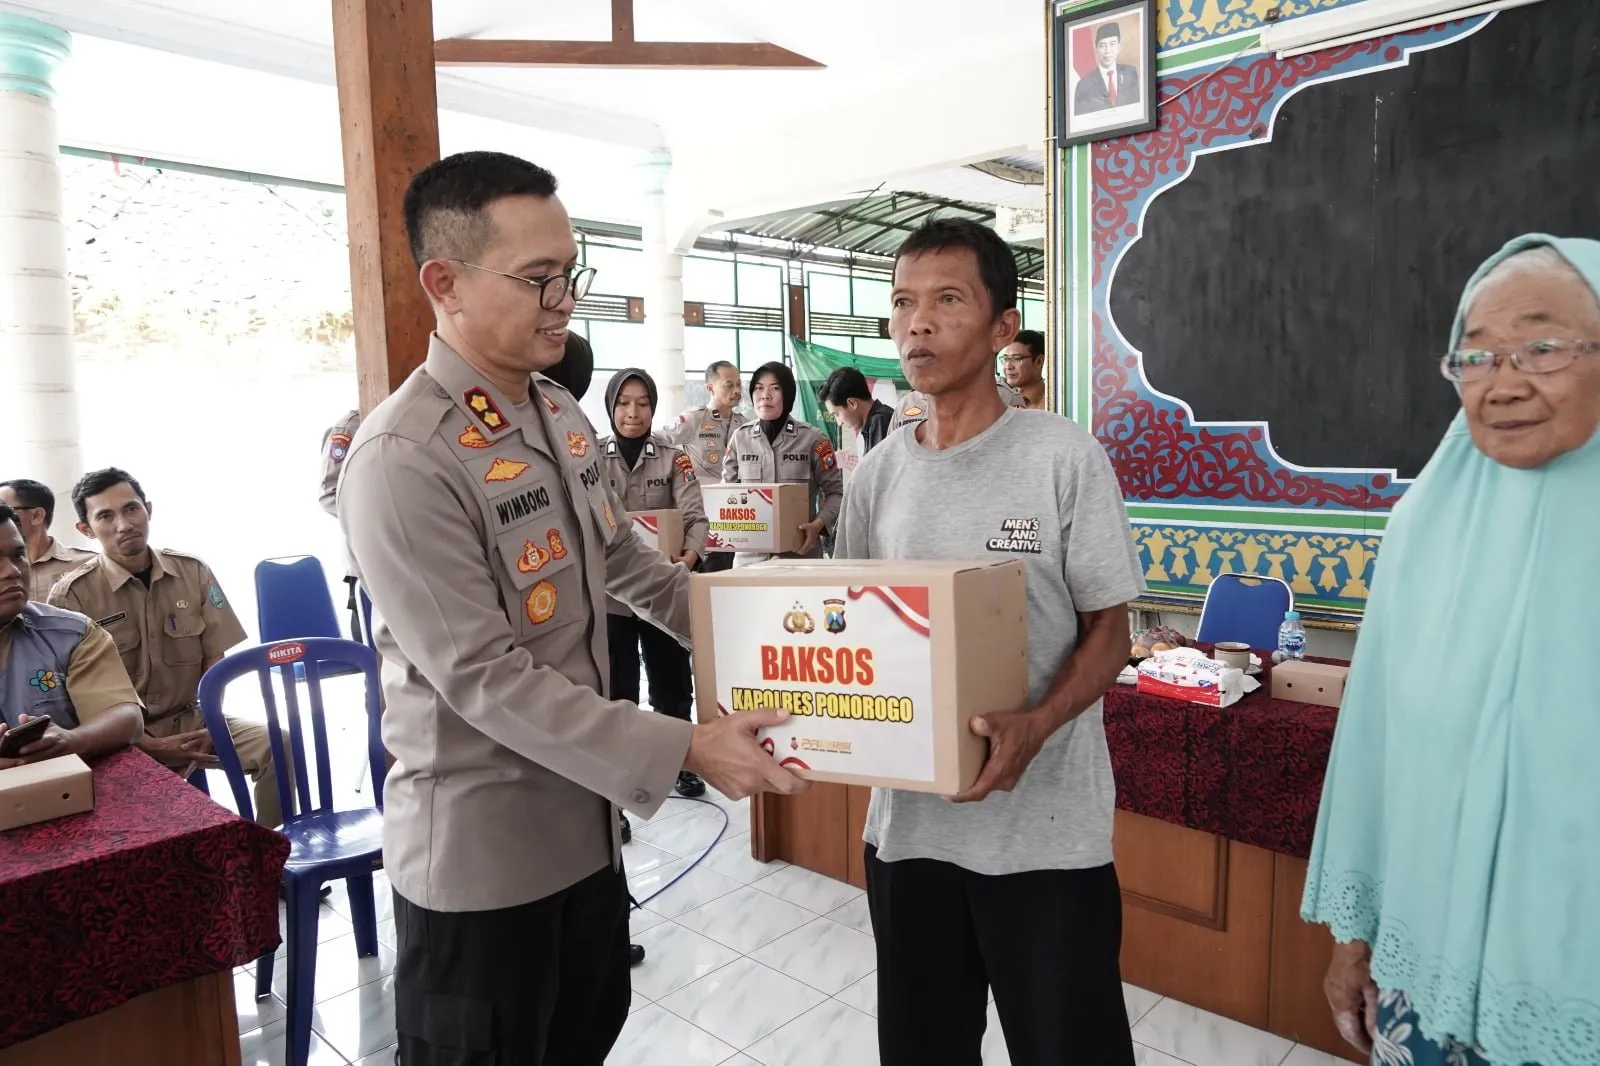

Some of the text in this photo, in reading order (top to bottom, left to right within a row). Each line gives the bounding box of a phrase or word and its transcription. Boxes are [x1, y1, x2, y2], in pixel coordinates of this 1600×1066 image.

[783, 453, 809, 462] POLRI
[496, 486, 550, 526] WIMBOKO
[720, 508, 756, 520] BAKSOS
[1001, 517, 1040, 531] MEN'S
[1009, 529, 1037, 541] AND
[269, 646, 302, 660] NIKITA
[761, 645, 874, 686] BAKSOS
[816, 692, 914, 723] PONOROGO
